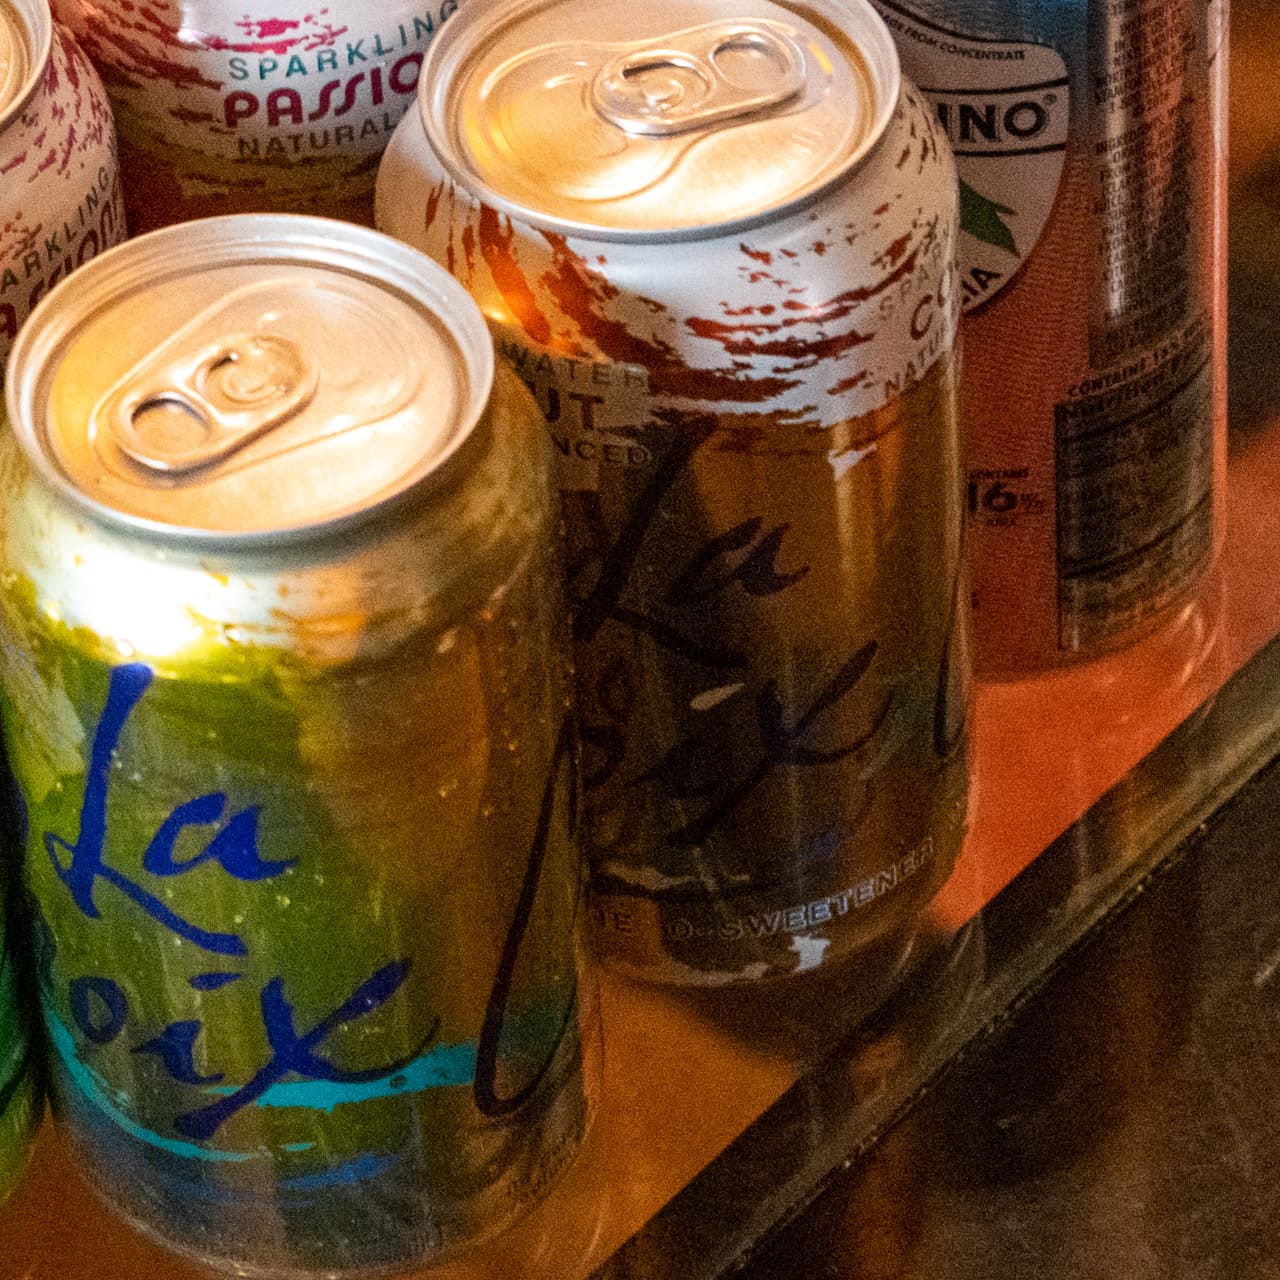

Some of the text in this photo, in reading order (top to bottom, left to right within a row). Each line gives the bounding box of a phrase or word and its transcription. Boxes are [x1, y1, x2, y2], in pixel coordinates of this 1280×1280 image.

[905, 25, 938, 49] FROM
[940, 41, 1026, 61] CONCENTRATE
[43, 662, 300, 956] La
